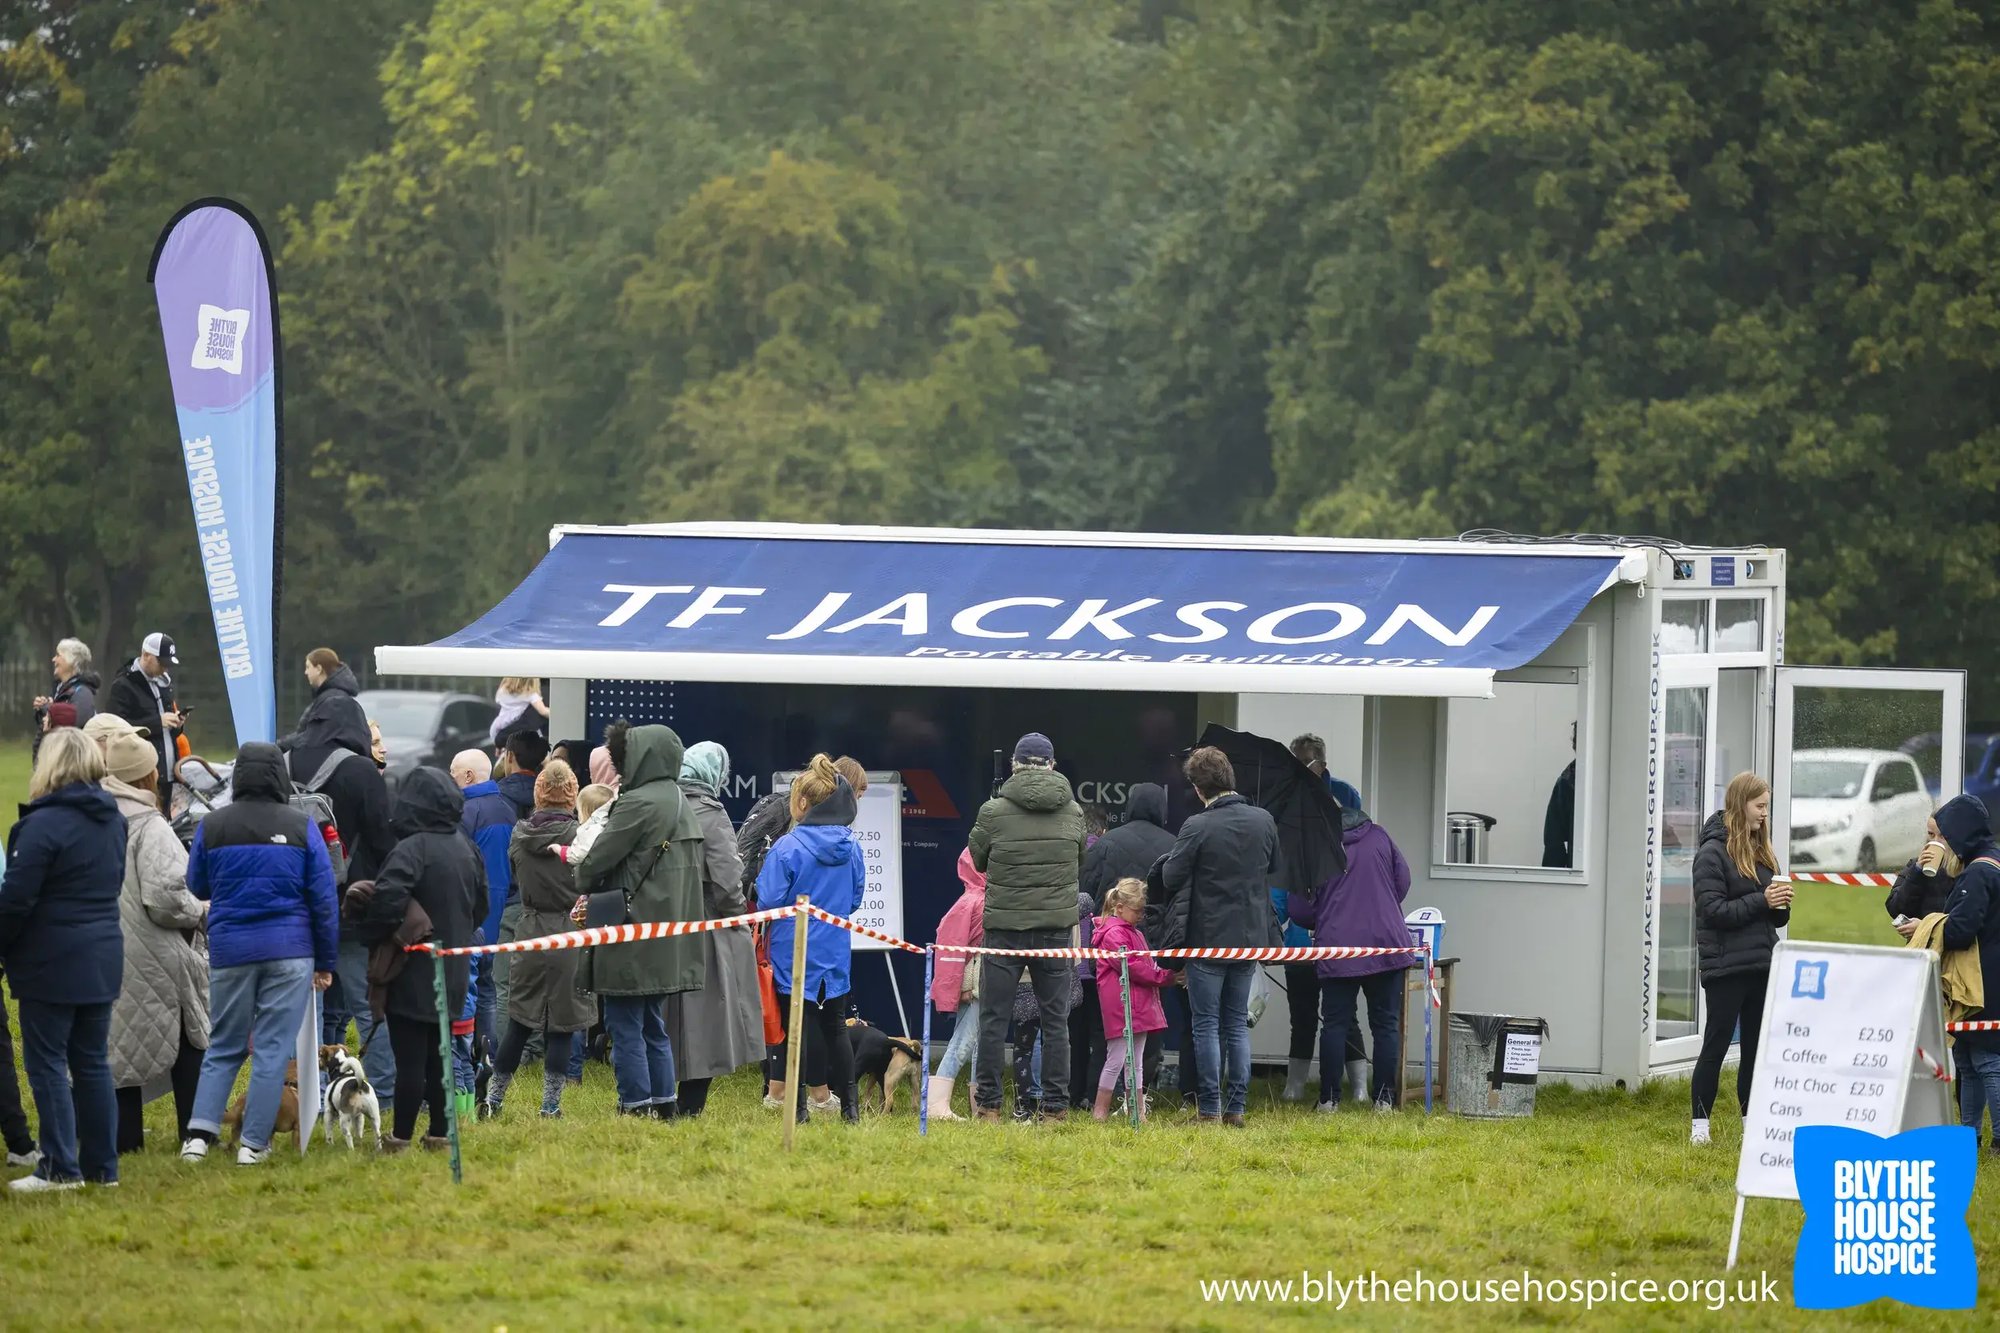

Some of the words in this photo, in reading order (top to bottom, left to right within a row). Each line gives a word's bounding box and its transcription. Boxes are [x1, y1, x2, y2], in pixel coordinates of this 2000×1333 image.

[597, 584, 767, 629] TF
[766, 592, 1500, 648] JACKSON
[905, 646, 1153, 662] Portable
[1168, 652, 1446, 667] Buildings
[717, 774, 762, 799] RM.
[1642, 632, 1660, 1034] WWW.JACKSON-GROUP.CO.UK
[866, 865, 883, 875] .50
[865, 883, 882, 892] .50
[857, 900, 885, 910] 1.00
[856, 918, 885, 928] £2.50
[1785, 1022, 1811, 1038] Tea
[1858, 1027, 1894, 1043] £2.50
[1782, 1047, 1828, 1065] Coffee
[1852, 1053, 1888, 1069] £2.50
[1774, 1076, 1801, 1092] Hot
[1803, 1077, 1838, 1094] Choc
[1850, 1081, 1885, 1097] £2.50
[1769, 1101, 1803, 1118] Cans
[1845, 1107, 1877, 1123] £1.50
[1765, 1127, 1793, 1142] Wat
